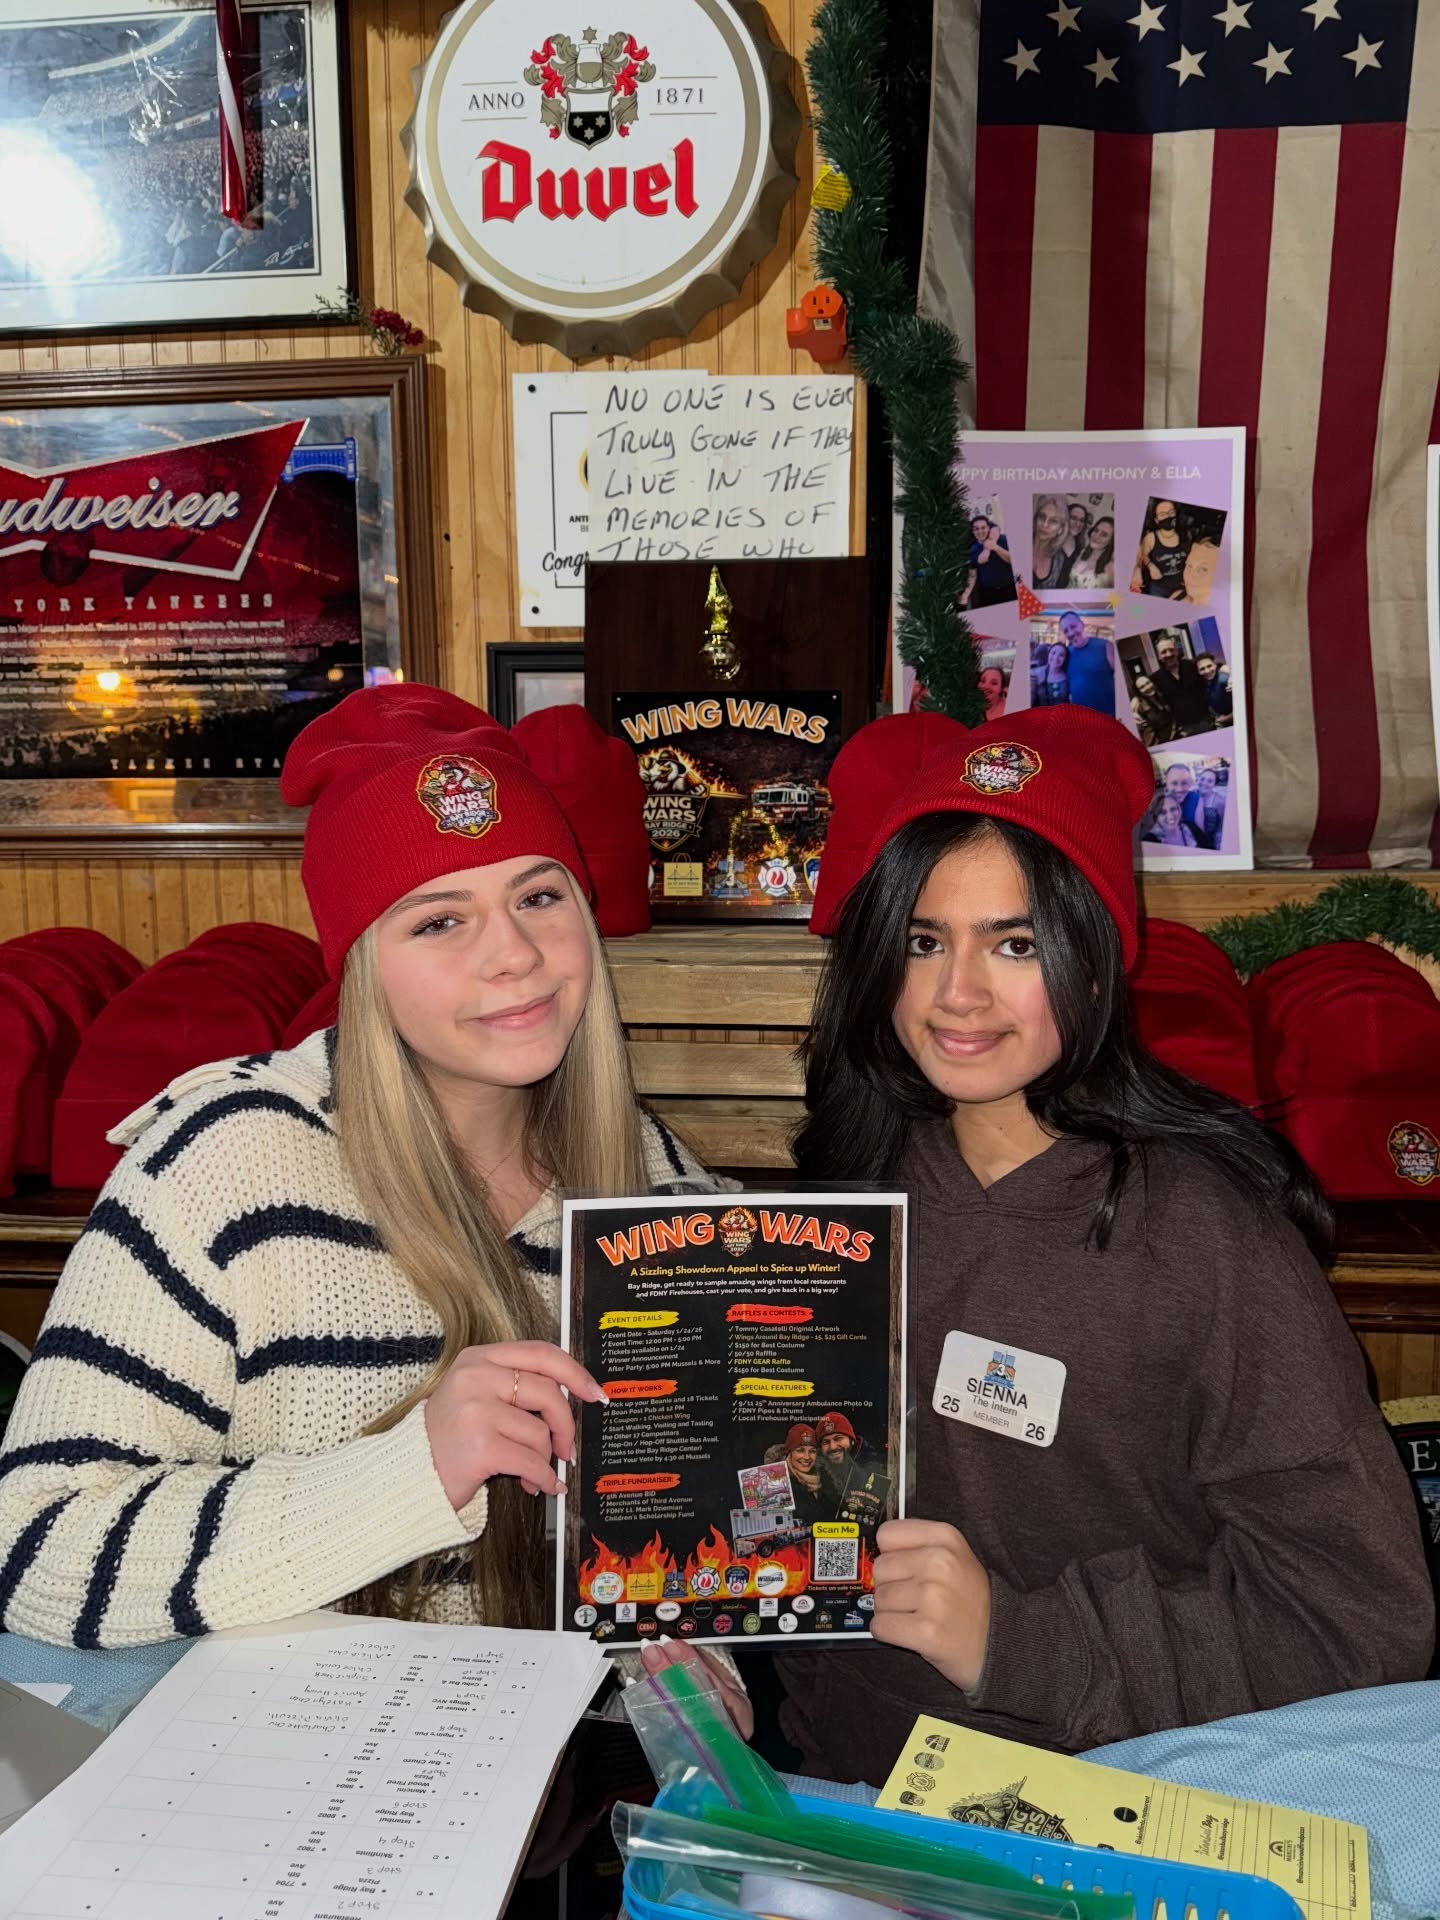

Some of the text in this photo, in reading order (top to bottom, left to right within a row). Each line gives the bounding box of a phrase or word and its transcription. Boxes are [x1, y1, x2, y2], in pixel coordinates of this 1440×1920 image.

[468, 87, 705, 110] ANNO 1871
[475, 137, 699, 224] Duvel
[605, 385, 648, 413] NO
[664, 383, 725, 413] ONE
[745, 388, 775, 411] IS
[597, 420, 676, 464] TRULY
[691, 424, 758, 452] GONE
[771, 426, 804, 450] IF
[952, 466, 1202, 481] PPY BIRTHDAY ANTHONY & ELLA
[604, 463, 831, 499] LIVE IN THE
[0, 476, 241, 535] udweiser
[607, 502, 836, 533] MEMORIES OF
[597, 535, 815, 561] THOSE WHO
[542, 551, 588, 577] Cong
[14, 593, 273, 612] YORK YANKEES
[621, 698, 829, 744] WING WARS
[110, 758, 210, 770] YANKEE
[440, 791, 482, 806] WING
[440, 799, 490, 816] WARS
[642, 808, 697, 822] WARS
[662, 821, 688, 829] RIDGE
[651, 829, 681, 838] 2026
[1400, 1158, 1435, 1167] WARS
[1401, 1152, 1431, 1160] WING
[596, 1210, 875, 1267] WING WARS
[630, 1268, 638, 1277] A
[640, 1267, 674, 1277] Sizzling
[675, 1265, 725, 1275] Showdown
[726, 1264, 758, 1275] Appeal
[771, 1264, 794, 1274] Spice
[795, 1266, 807, 1274] up
[808, 1263, 840, 1273] Winter!
[627, 1283, 640, 1291] Bay
[641, 1282, 663, 1290] Ridge,
[663, 1281, 675, 1289] get
[676, 1280, 695, 1288] ready
[704, 1279, 727, 1287] sample
[728, 1278, 755, 1286] amazing
[757, 1278, 776, 1286] wings
[635, 1291, 649, 1299] and
[669, 1288, 705, 1296] Firehouses,
[647, 1329, 675, 1337] Saturday
[789, 1325, 814, 1333] Original
[632, 1346, 660, 1354] available
[631, 1353, 679, 1362] Announcement
[966, 1377, 1028, 1409] SIENNA
[940, 1395, 1018, 1416] 25 The Intern
[973, 1410, 1010, 1428] MEMBER
[1025, 1422, 1046, 1441] 26
[602, 1479, 627, 1487] TRIPLE
[816, 1525, 856, 1534] Scan Me
[375, 1808, 415, 1818] Bay Ridge
[378, 1817, 412, 1825] Istanbul
[1007, 1810, 1029, 1834] NG
[1023, 1811, 1046, 1836] RS
[355, 1850, 394, 1858] Skinflints
[275, 1879, 296, 1887] 7704
[358, 1877, 381, 1885] Pizza
[332, 1884, 376, 1894] Bay Ridge
[267, 1899, 284, 1907] Ave
